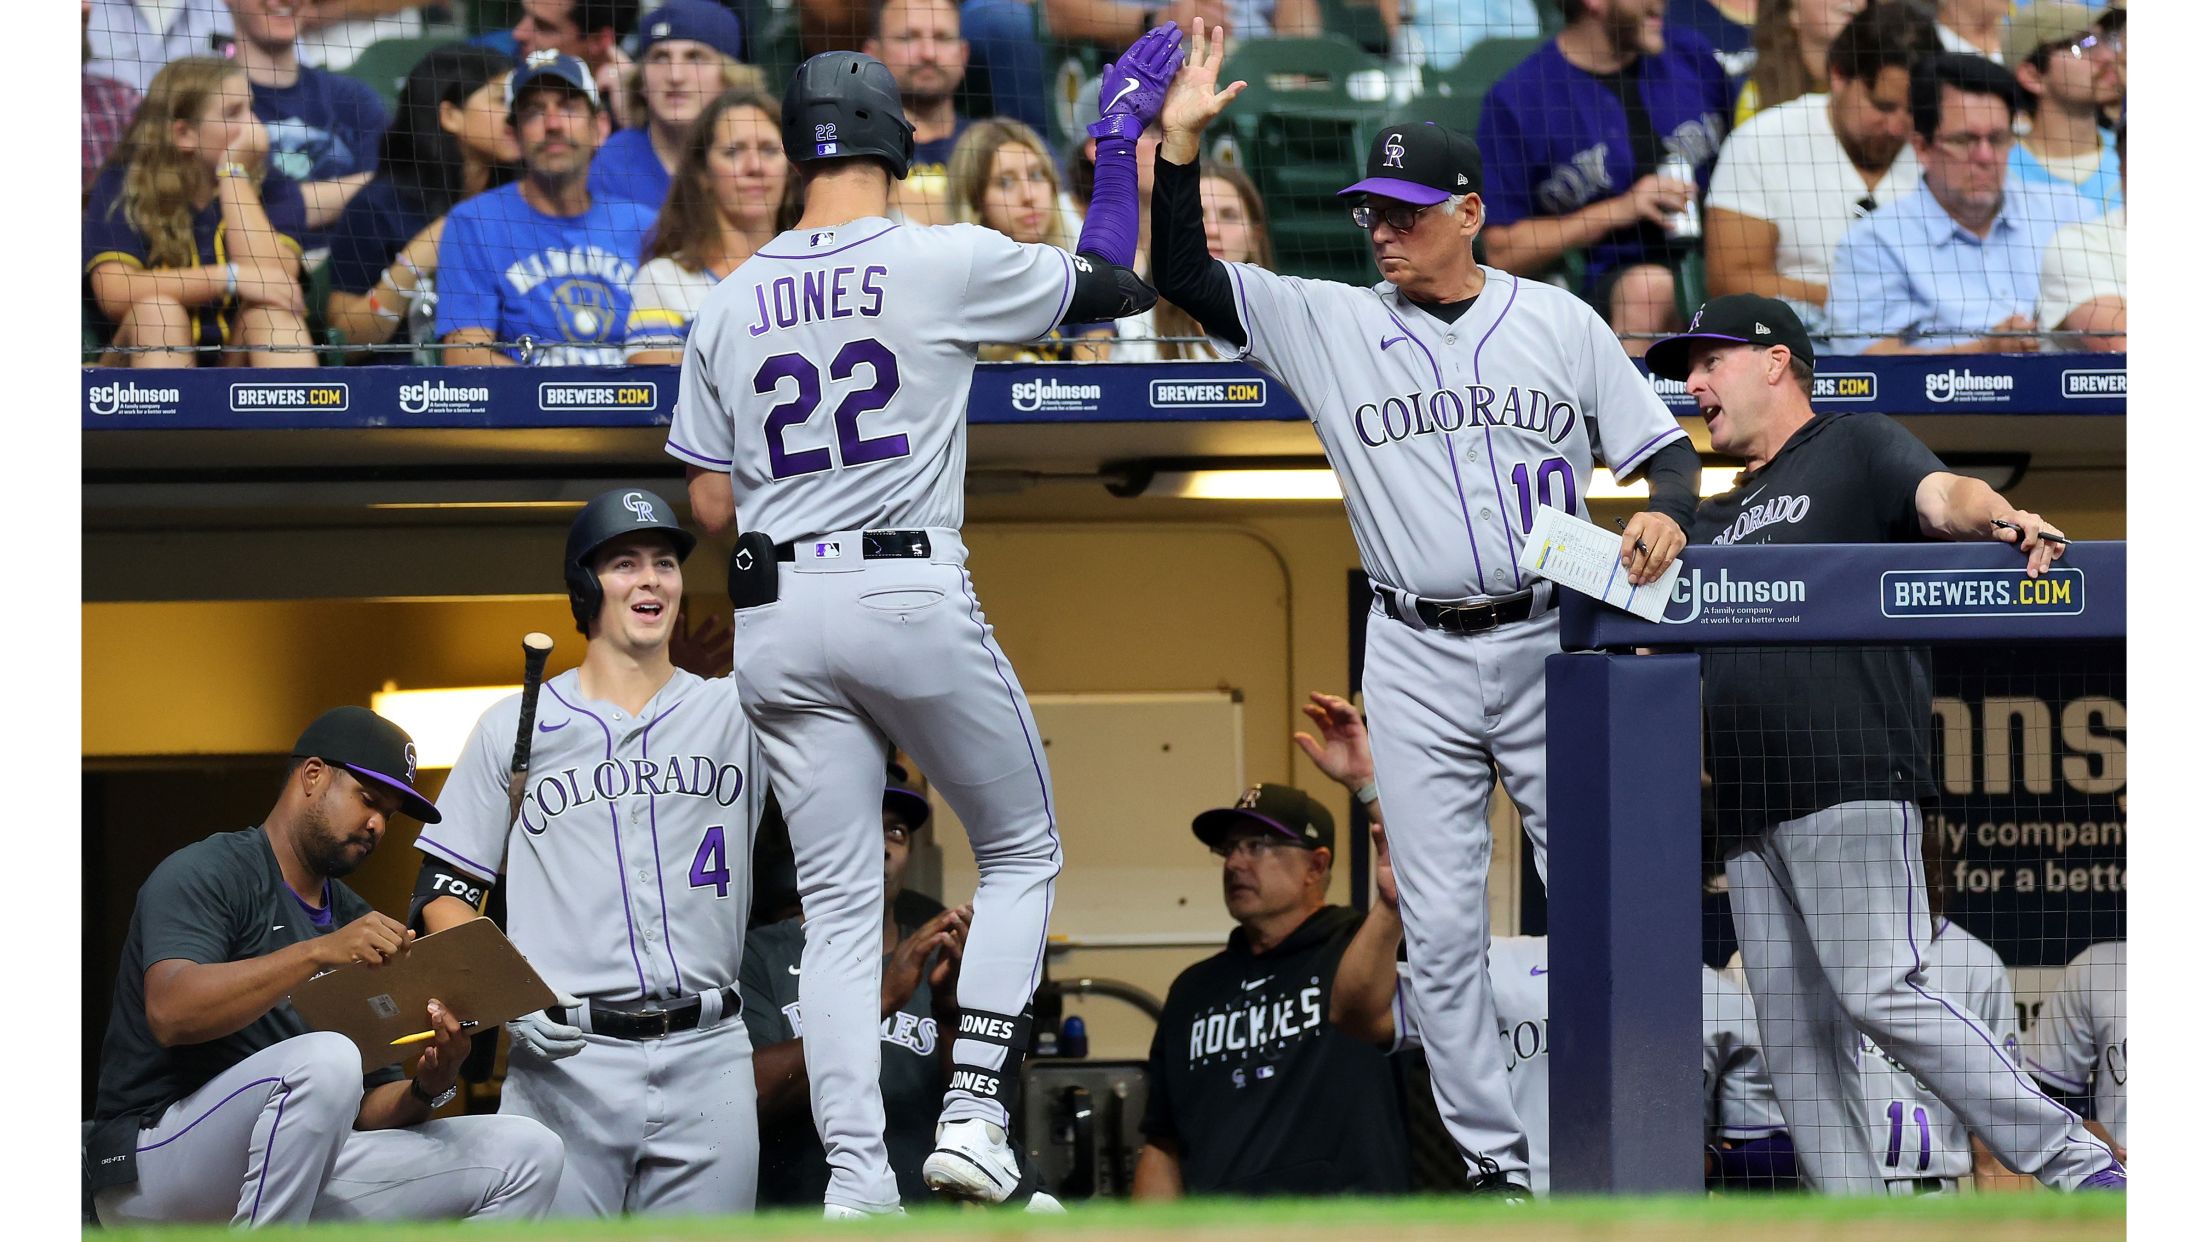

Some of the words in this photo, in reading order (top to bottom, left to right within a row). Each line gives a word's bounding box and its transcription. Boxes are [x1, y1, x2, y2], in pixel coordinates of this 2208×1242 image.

[815, 123, 837, 141] 22
[748, 265, 888, 338] JONES
[238, 390, 341, 404] BREWERS.COM
[547, 389, 649, 404] BREWERS.COM
[1158, 385, 1258, 401] BREWERS.COM
[2070, 376, 2127, 392] BREWER
[752, 337, 912, 482] 22
[1353, 384, 1577, 448] COLORADO
[1511, 456, 1578, 535] 10
[1711, 495, 1810, 546] OLORADO
[1894, 579, 2071, 606] BREWERS.COM
[1710, 616, 1730, 624] work
[1732, 616, 1742, 624] for
[1778, 615, 1800, 623] world
[1712, 606, 1735, 615] family
[1737, 606, 1773, 615] company
[520, 754, 745, 836] COLORADO
[1977, 822, 2127, 853] compan
[688, 825, 732, 900] 4
[1952, 860, 2005, 893] for
[2016, 867, 2036, 892] a
[959, 1014, 1014, 1040] JONES
[1190, 986, 1320, 1060] ROCKIES
[949, 1070, 1000, 1096] JONES
[1884, 1098, 1932, 1172] 11
